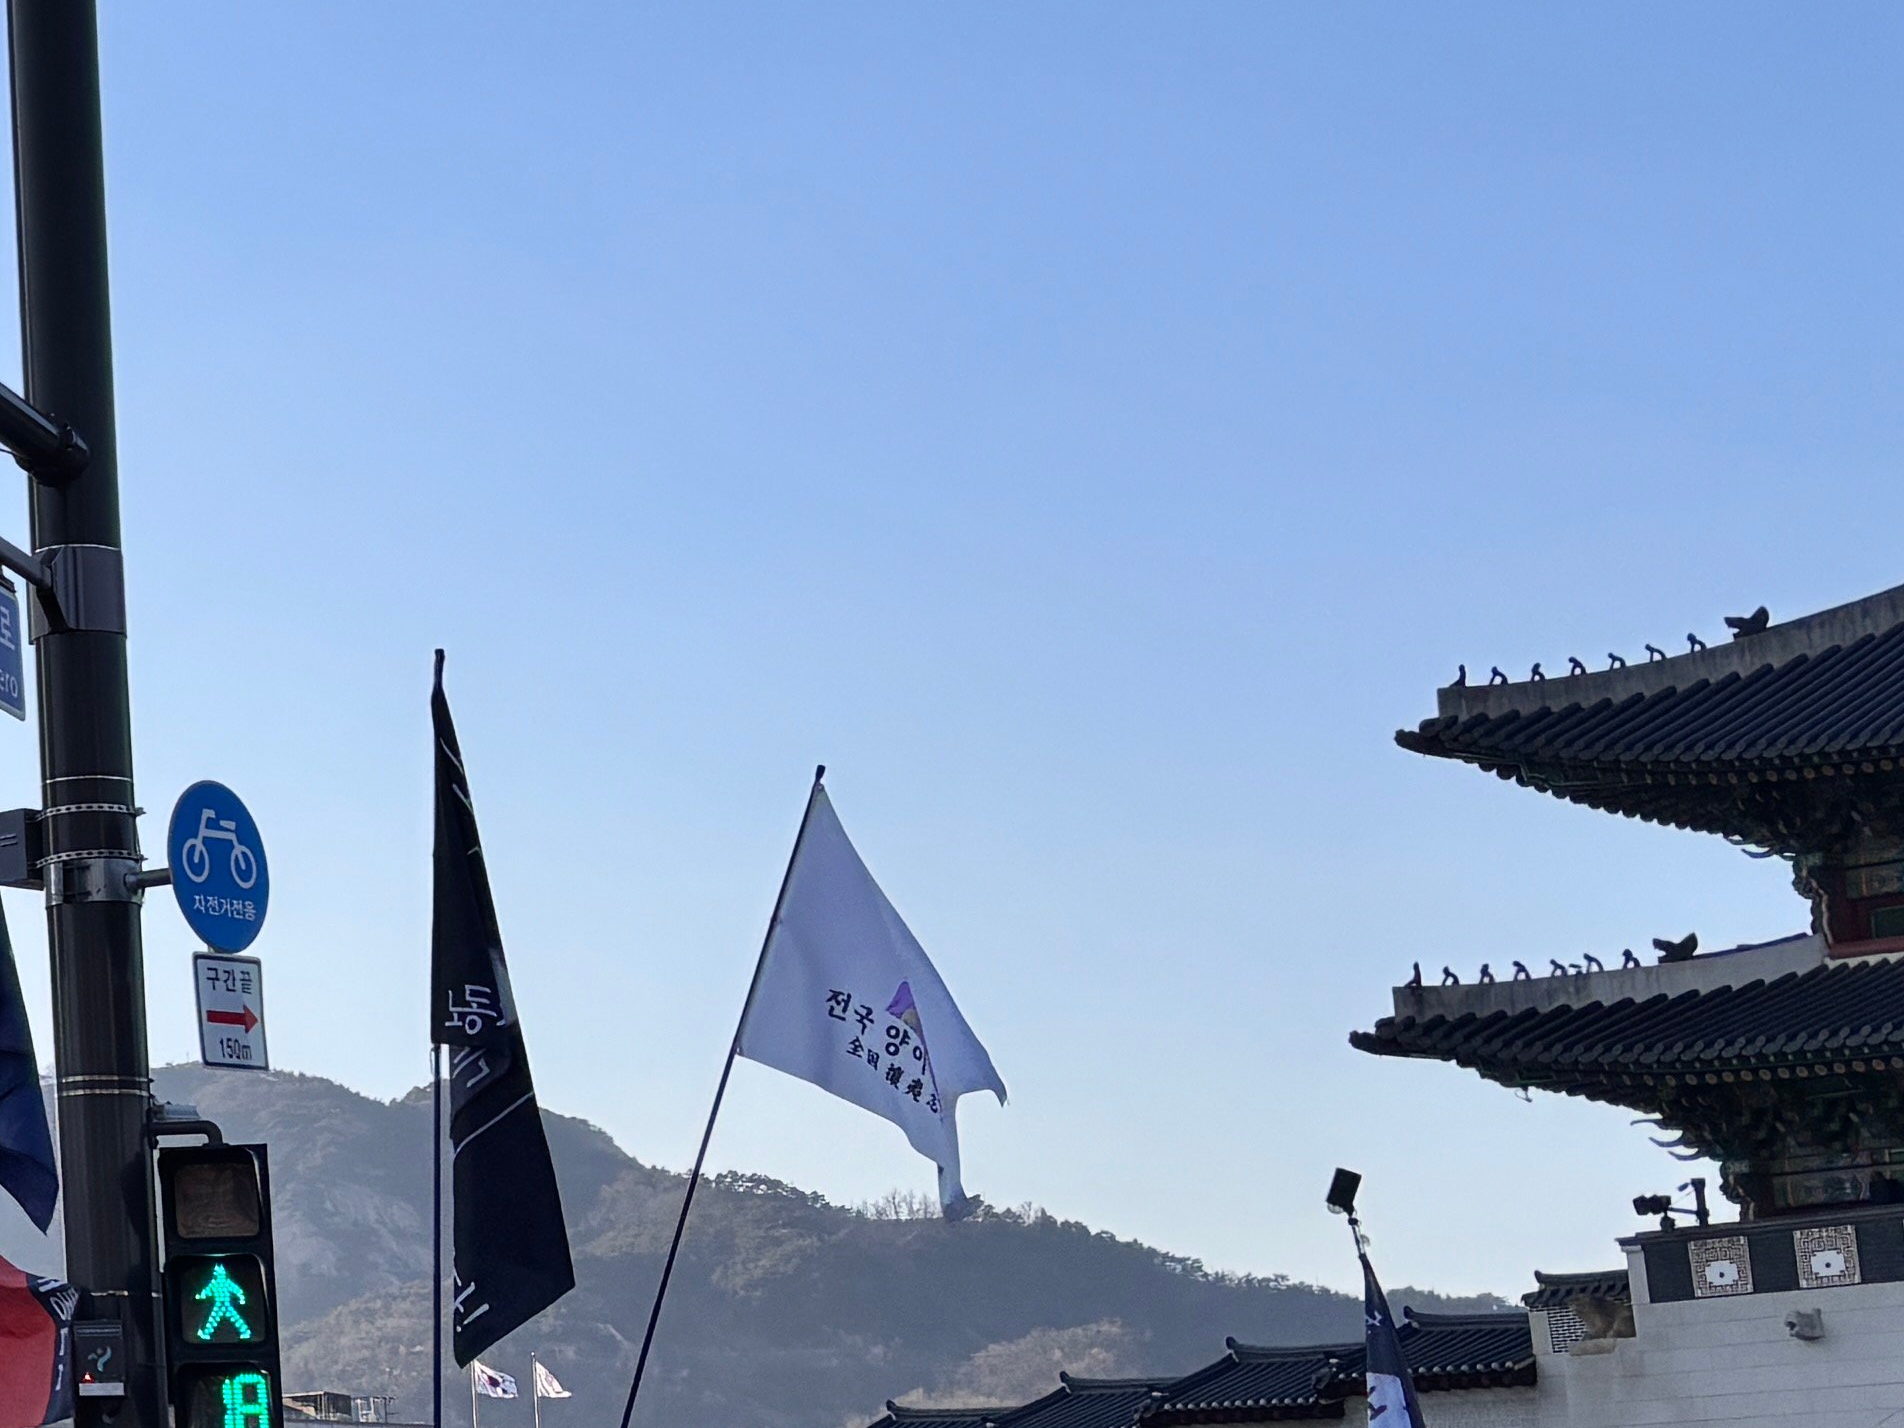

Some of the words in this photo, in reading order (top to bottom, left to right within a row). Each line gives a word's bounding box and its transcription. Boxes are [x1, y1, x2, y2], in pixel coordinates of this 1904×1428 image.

[193, 894, 257, 922] 자전거전용
[826, 989, 875, 1036] 전국
[219, 1038, 252, 1060] 150m
